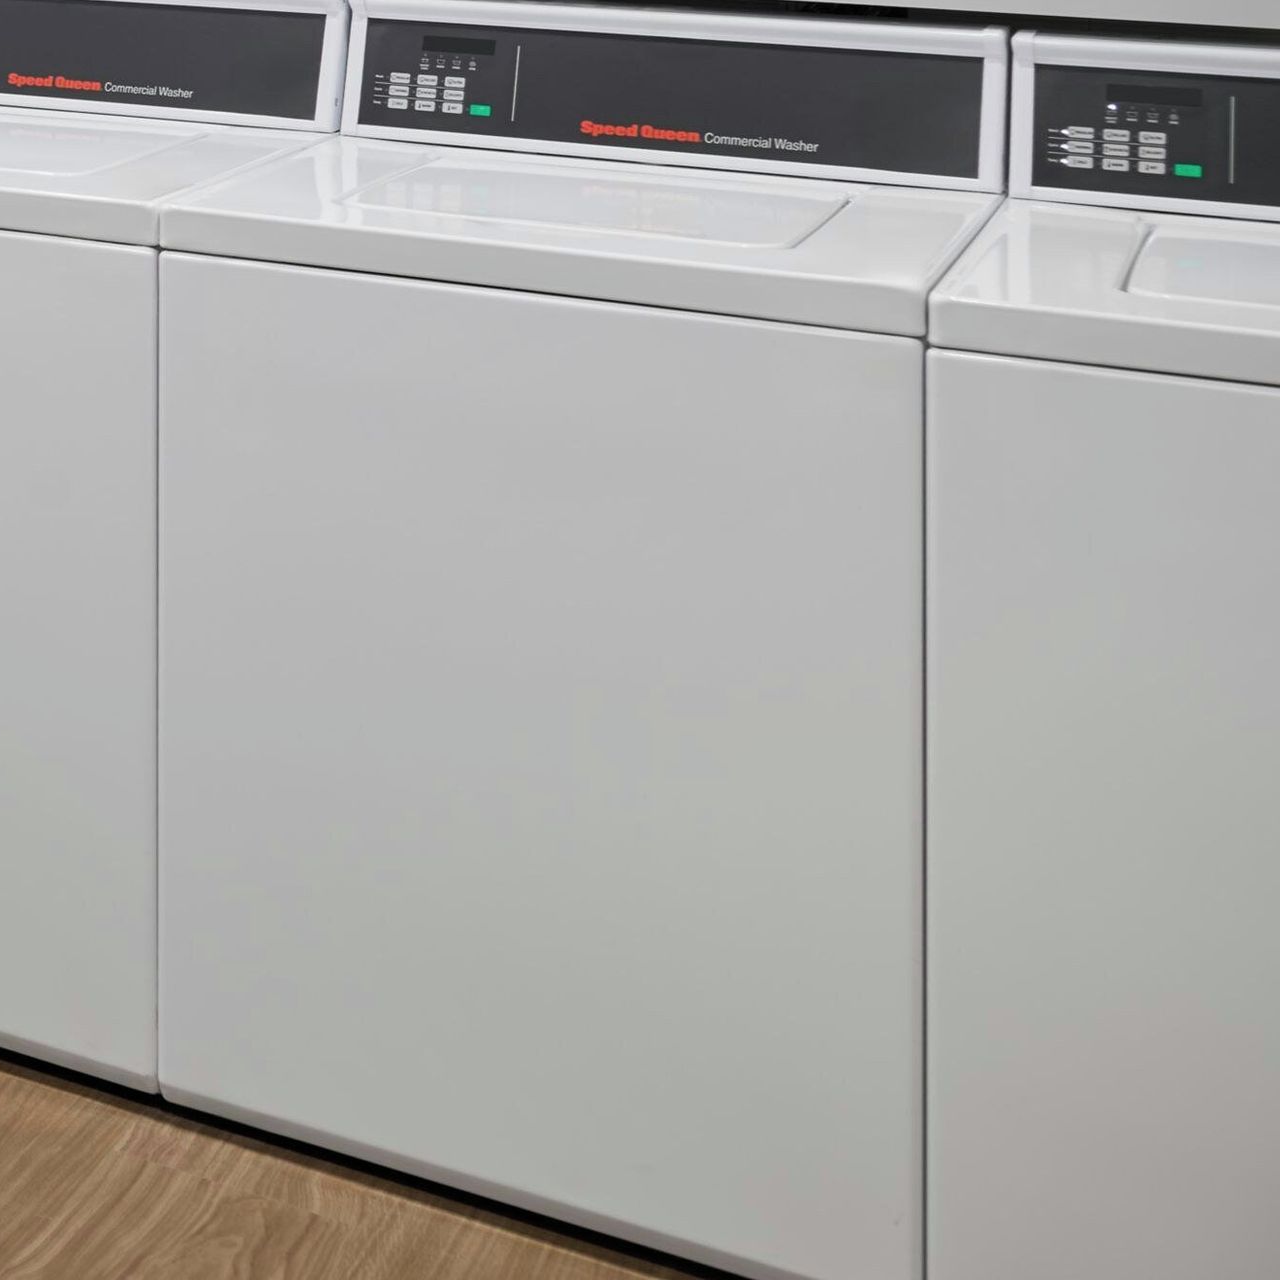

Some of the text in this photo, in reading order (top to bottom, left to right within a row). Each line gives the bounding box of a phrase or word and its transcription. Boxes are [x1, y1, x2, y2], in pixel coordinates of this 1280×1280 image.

[8, 72, 194, 99] Speed Queen Commercial Washer
[580, 120, 819, 153] Speed Queen Commercial Washer
